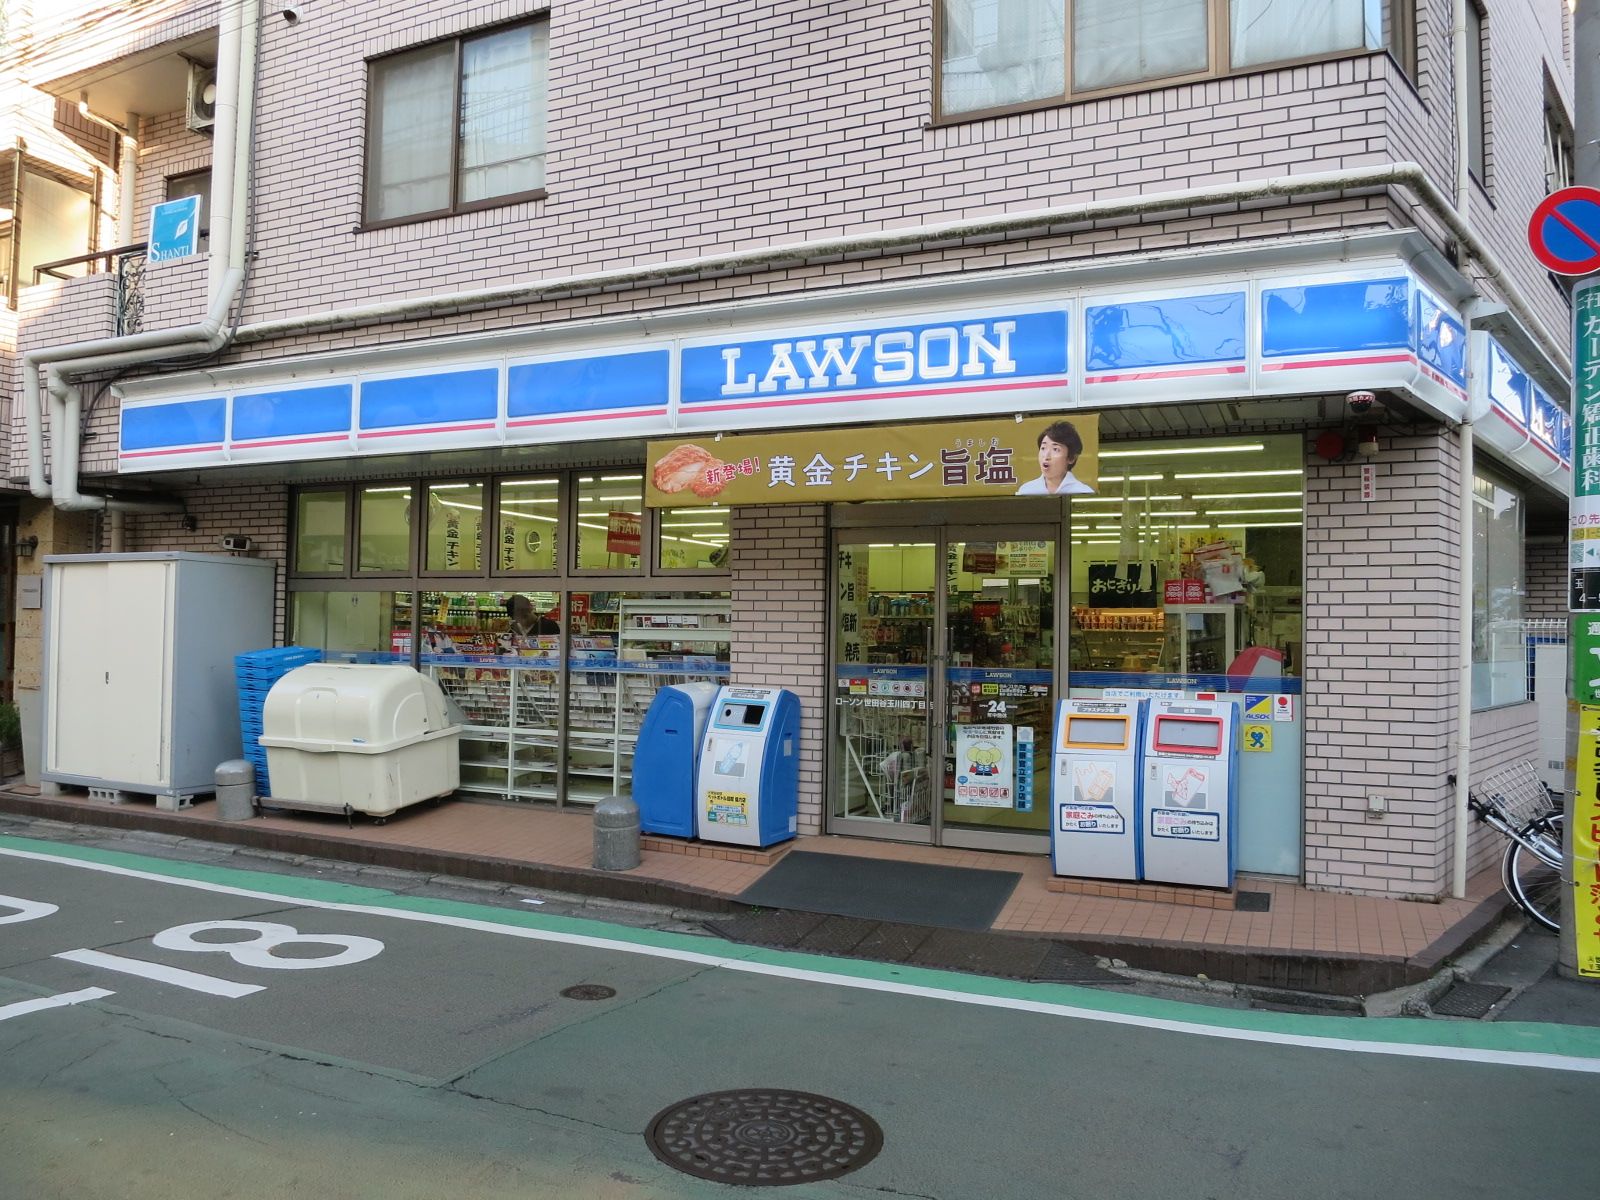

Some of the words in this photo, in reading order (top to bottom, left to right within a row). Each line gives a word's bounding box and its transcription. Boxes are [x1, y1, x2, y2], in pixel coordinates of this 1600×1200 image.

[150, 242, 189, 261] SHANTI
[721, 321, 1017, 395] LAWSON
[954, 438, 999, 447] うましお
[706, 457, 760, 484] 新登場!
[768, 446, 1017, 488] 黄金チキン旨塩
[447, 519, 459, 567] 黄金チキン
[988, 700, 1006, 713] 24
